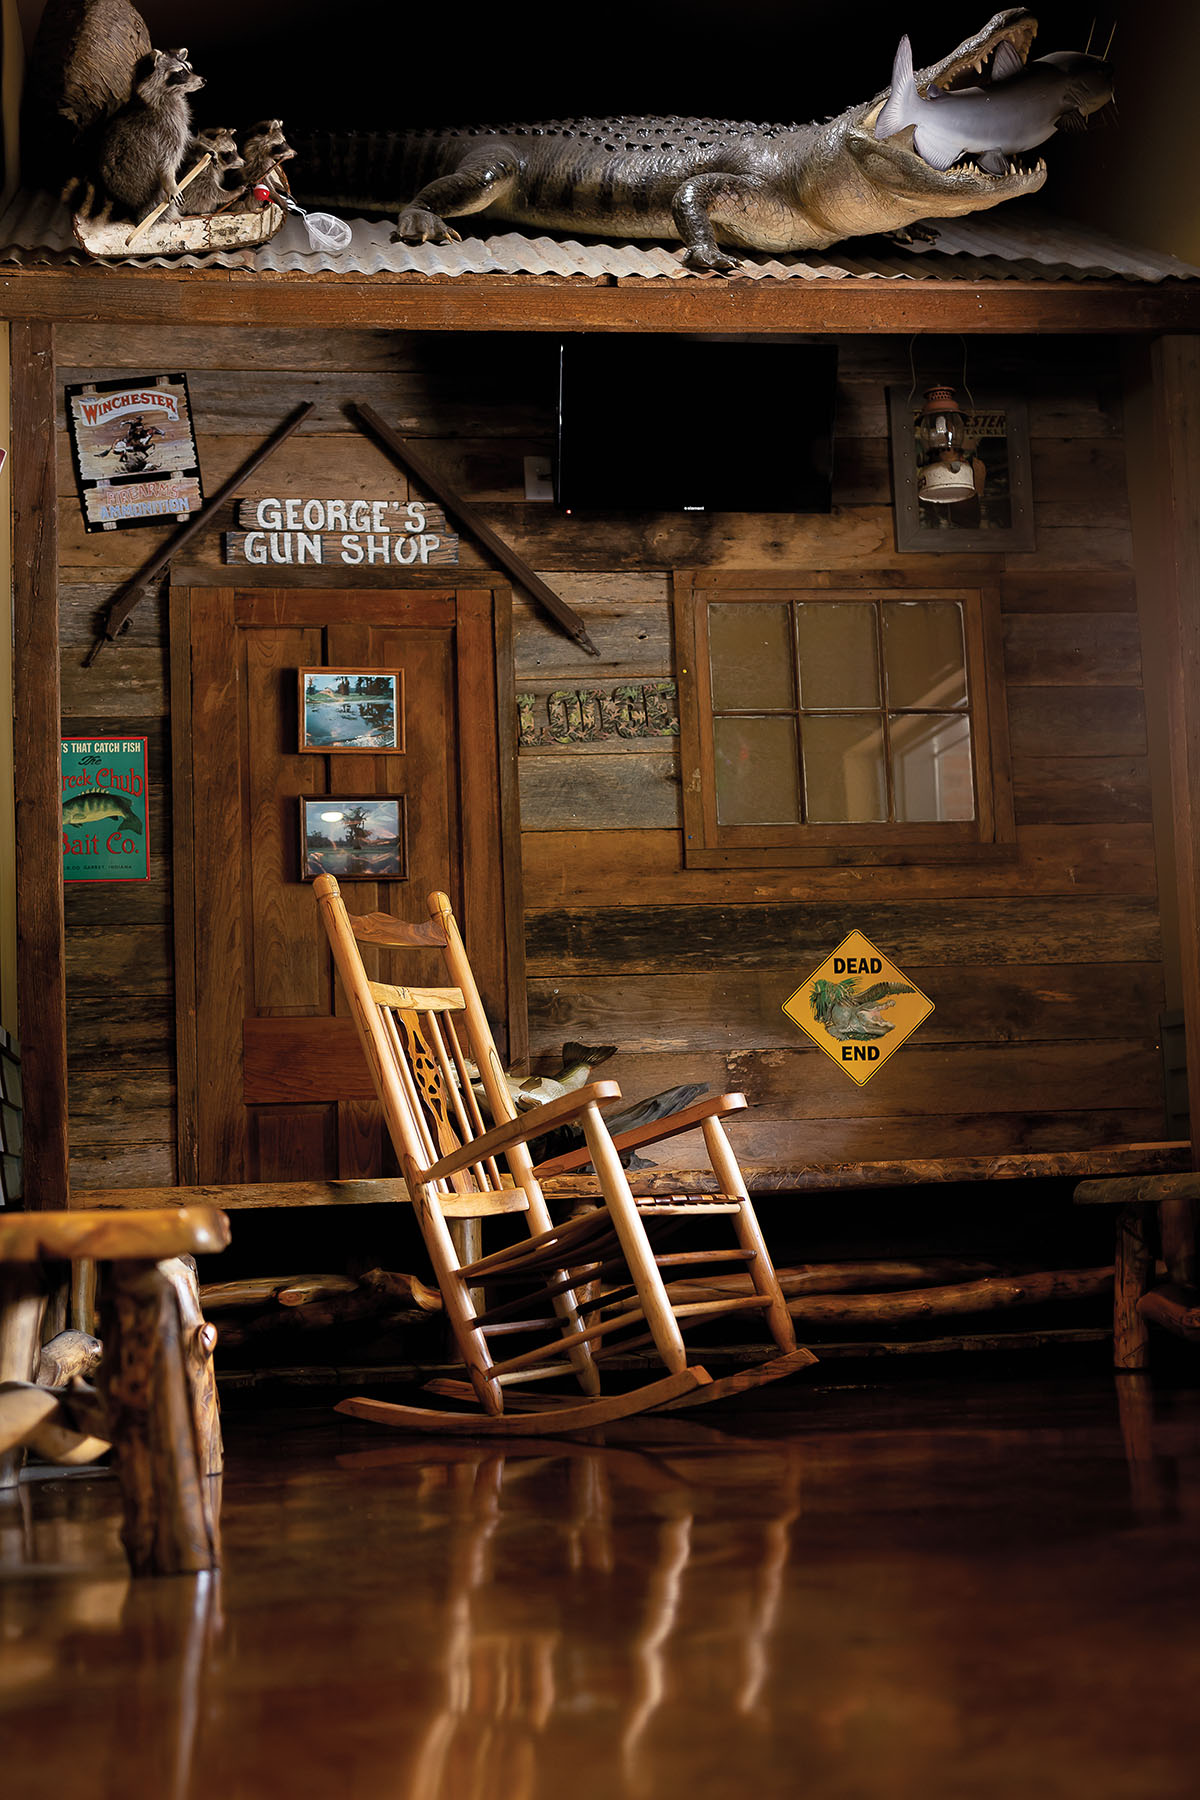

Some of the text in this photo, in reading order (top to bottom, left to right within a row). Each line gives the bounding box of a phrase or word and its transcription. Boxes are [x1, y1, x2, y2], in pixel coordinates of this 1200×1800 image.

[81, 392, 177, 425] WINCHESTER
[105, 482, 180, 505] FIREARMS
[100, 497, 190, 520] AMMONITION
[256, 498, 427, 533] GEORGE'S
[243, 531, 441, 565] GUN SHOP
[71, 742, 92, 753] THAT
[94, 742, 120, 753] CATCH
[122, 742, 141, 753] FISH
[96, 767, 144, 797] Chub
[106, 831, 139, 855] Co.
[833, 957, 883, 975] DEAD
[841, 1045, 881, 1061] END
